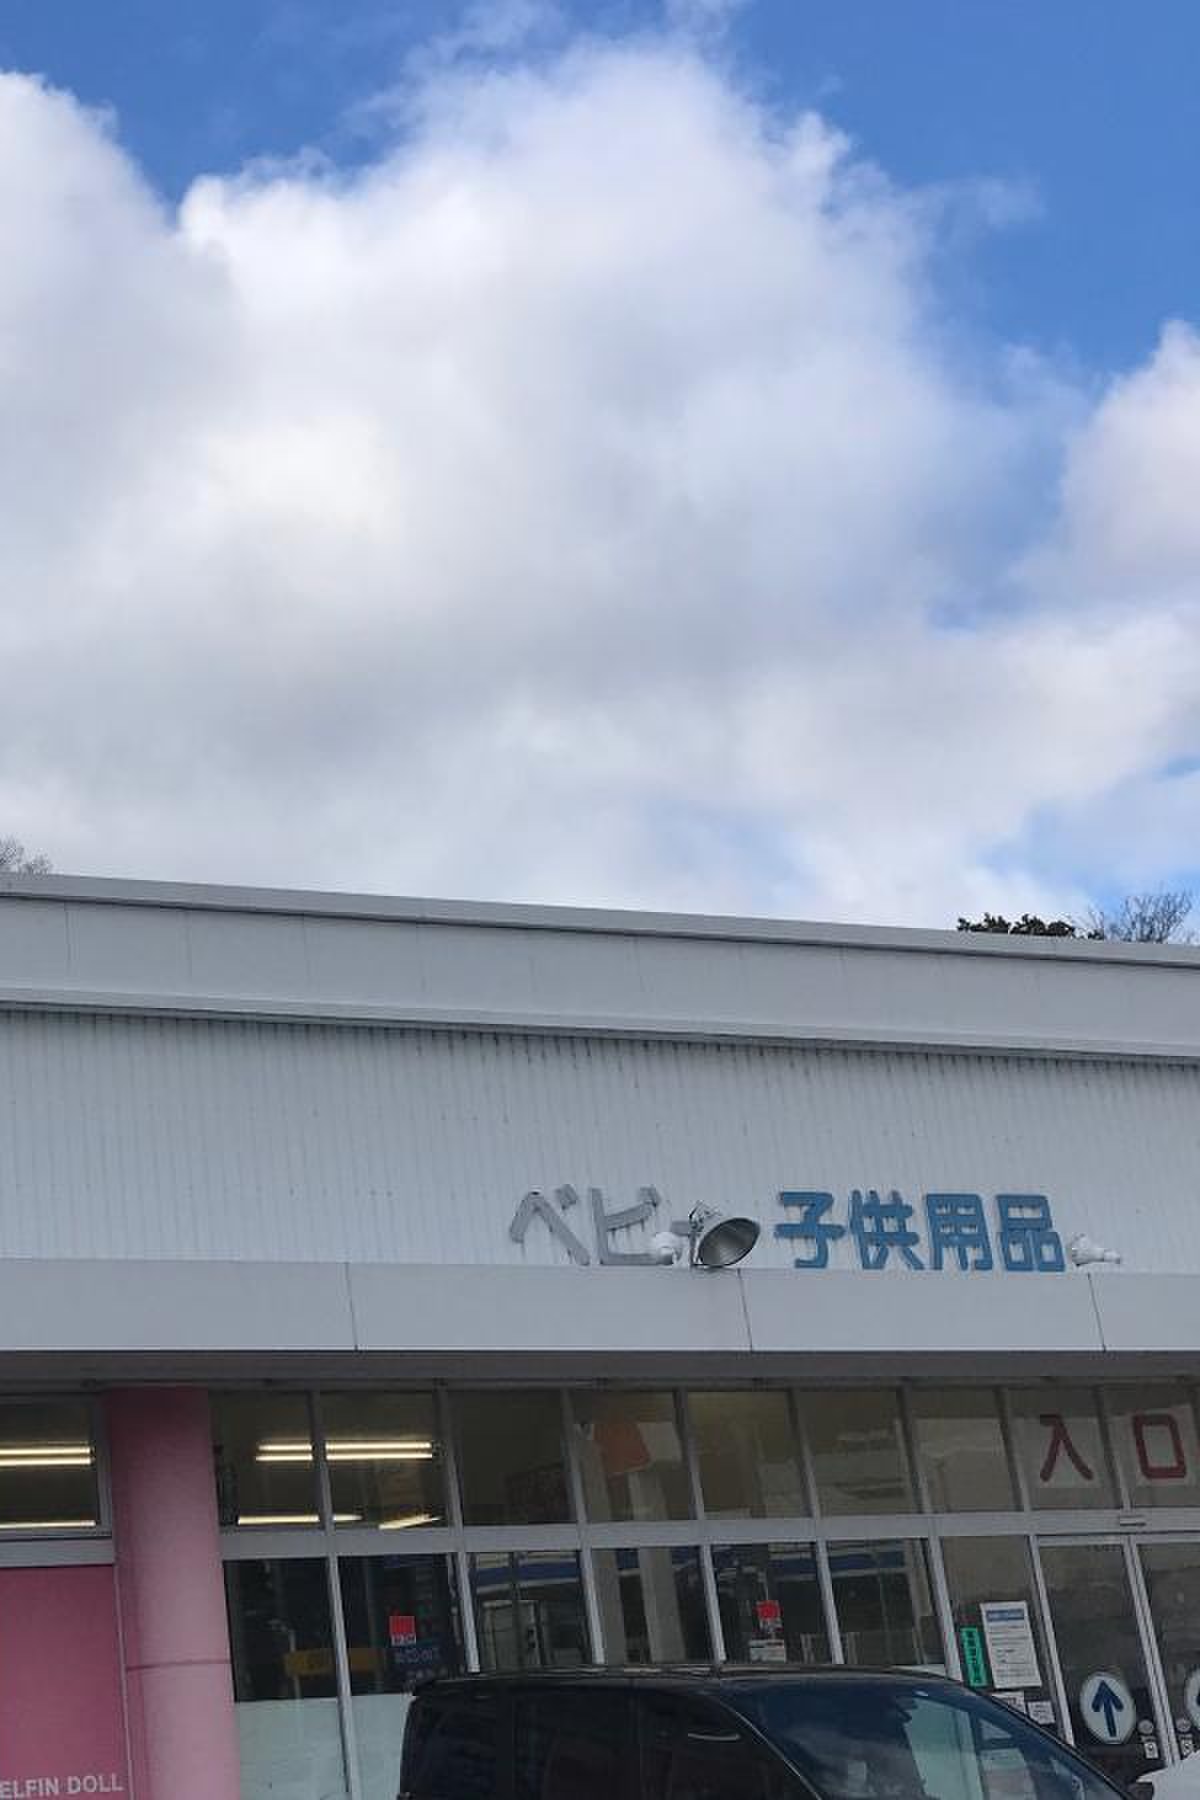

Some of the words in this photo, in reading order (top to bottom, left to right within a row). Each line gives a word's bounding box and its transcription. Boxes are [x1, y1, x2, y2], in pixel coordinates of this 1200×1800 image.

[508, 1184, 692, 1266] ベビ
[774, 1190, 1065, 1272] 子供用品
[1039, 1413, 1187, 1481] 入口
[0, 1777, 59, 1799] ELFIN
[66, 1773, 124, 1795] DOLL
